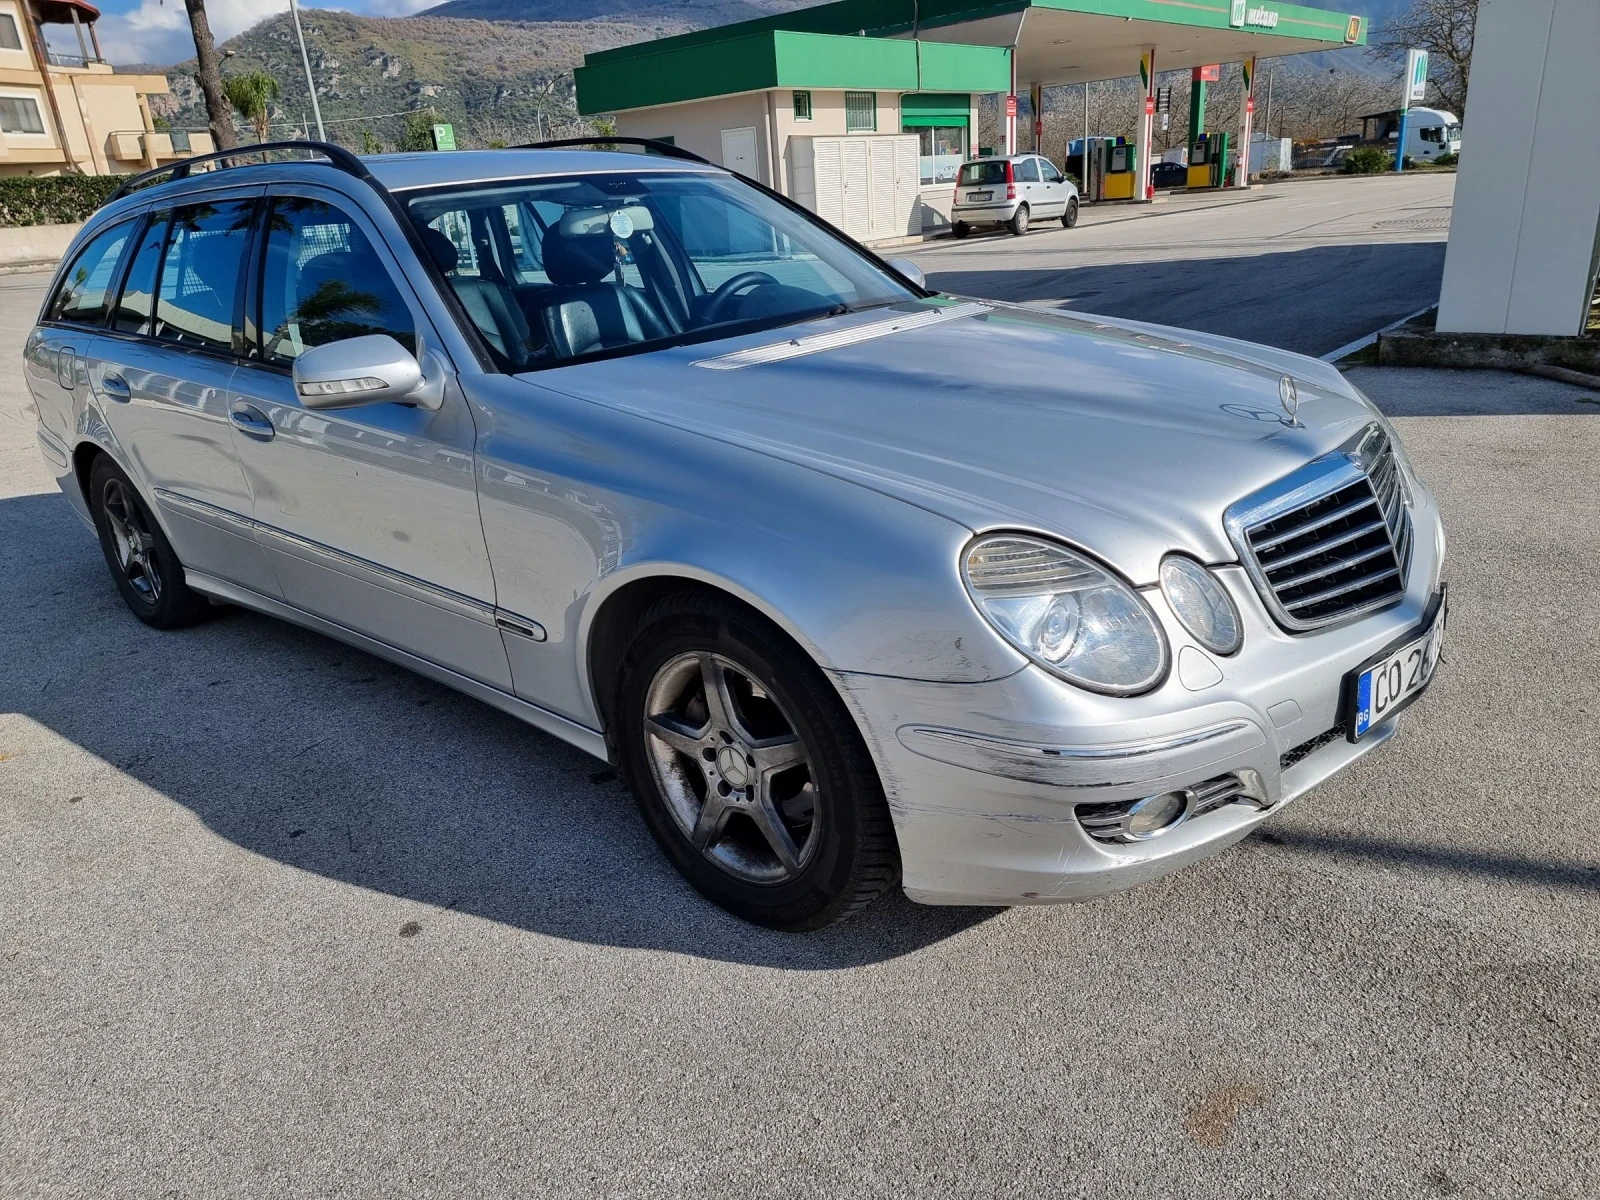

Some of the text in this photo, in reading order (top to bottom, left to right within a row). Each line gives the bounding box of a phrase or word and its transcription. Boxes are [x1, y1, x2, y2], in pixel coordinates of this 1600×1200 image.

[435, 126, 446, 142] P
[1375, 659, 1402, 714] CO
[1358, 709, 1369, 725] BG
